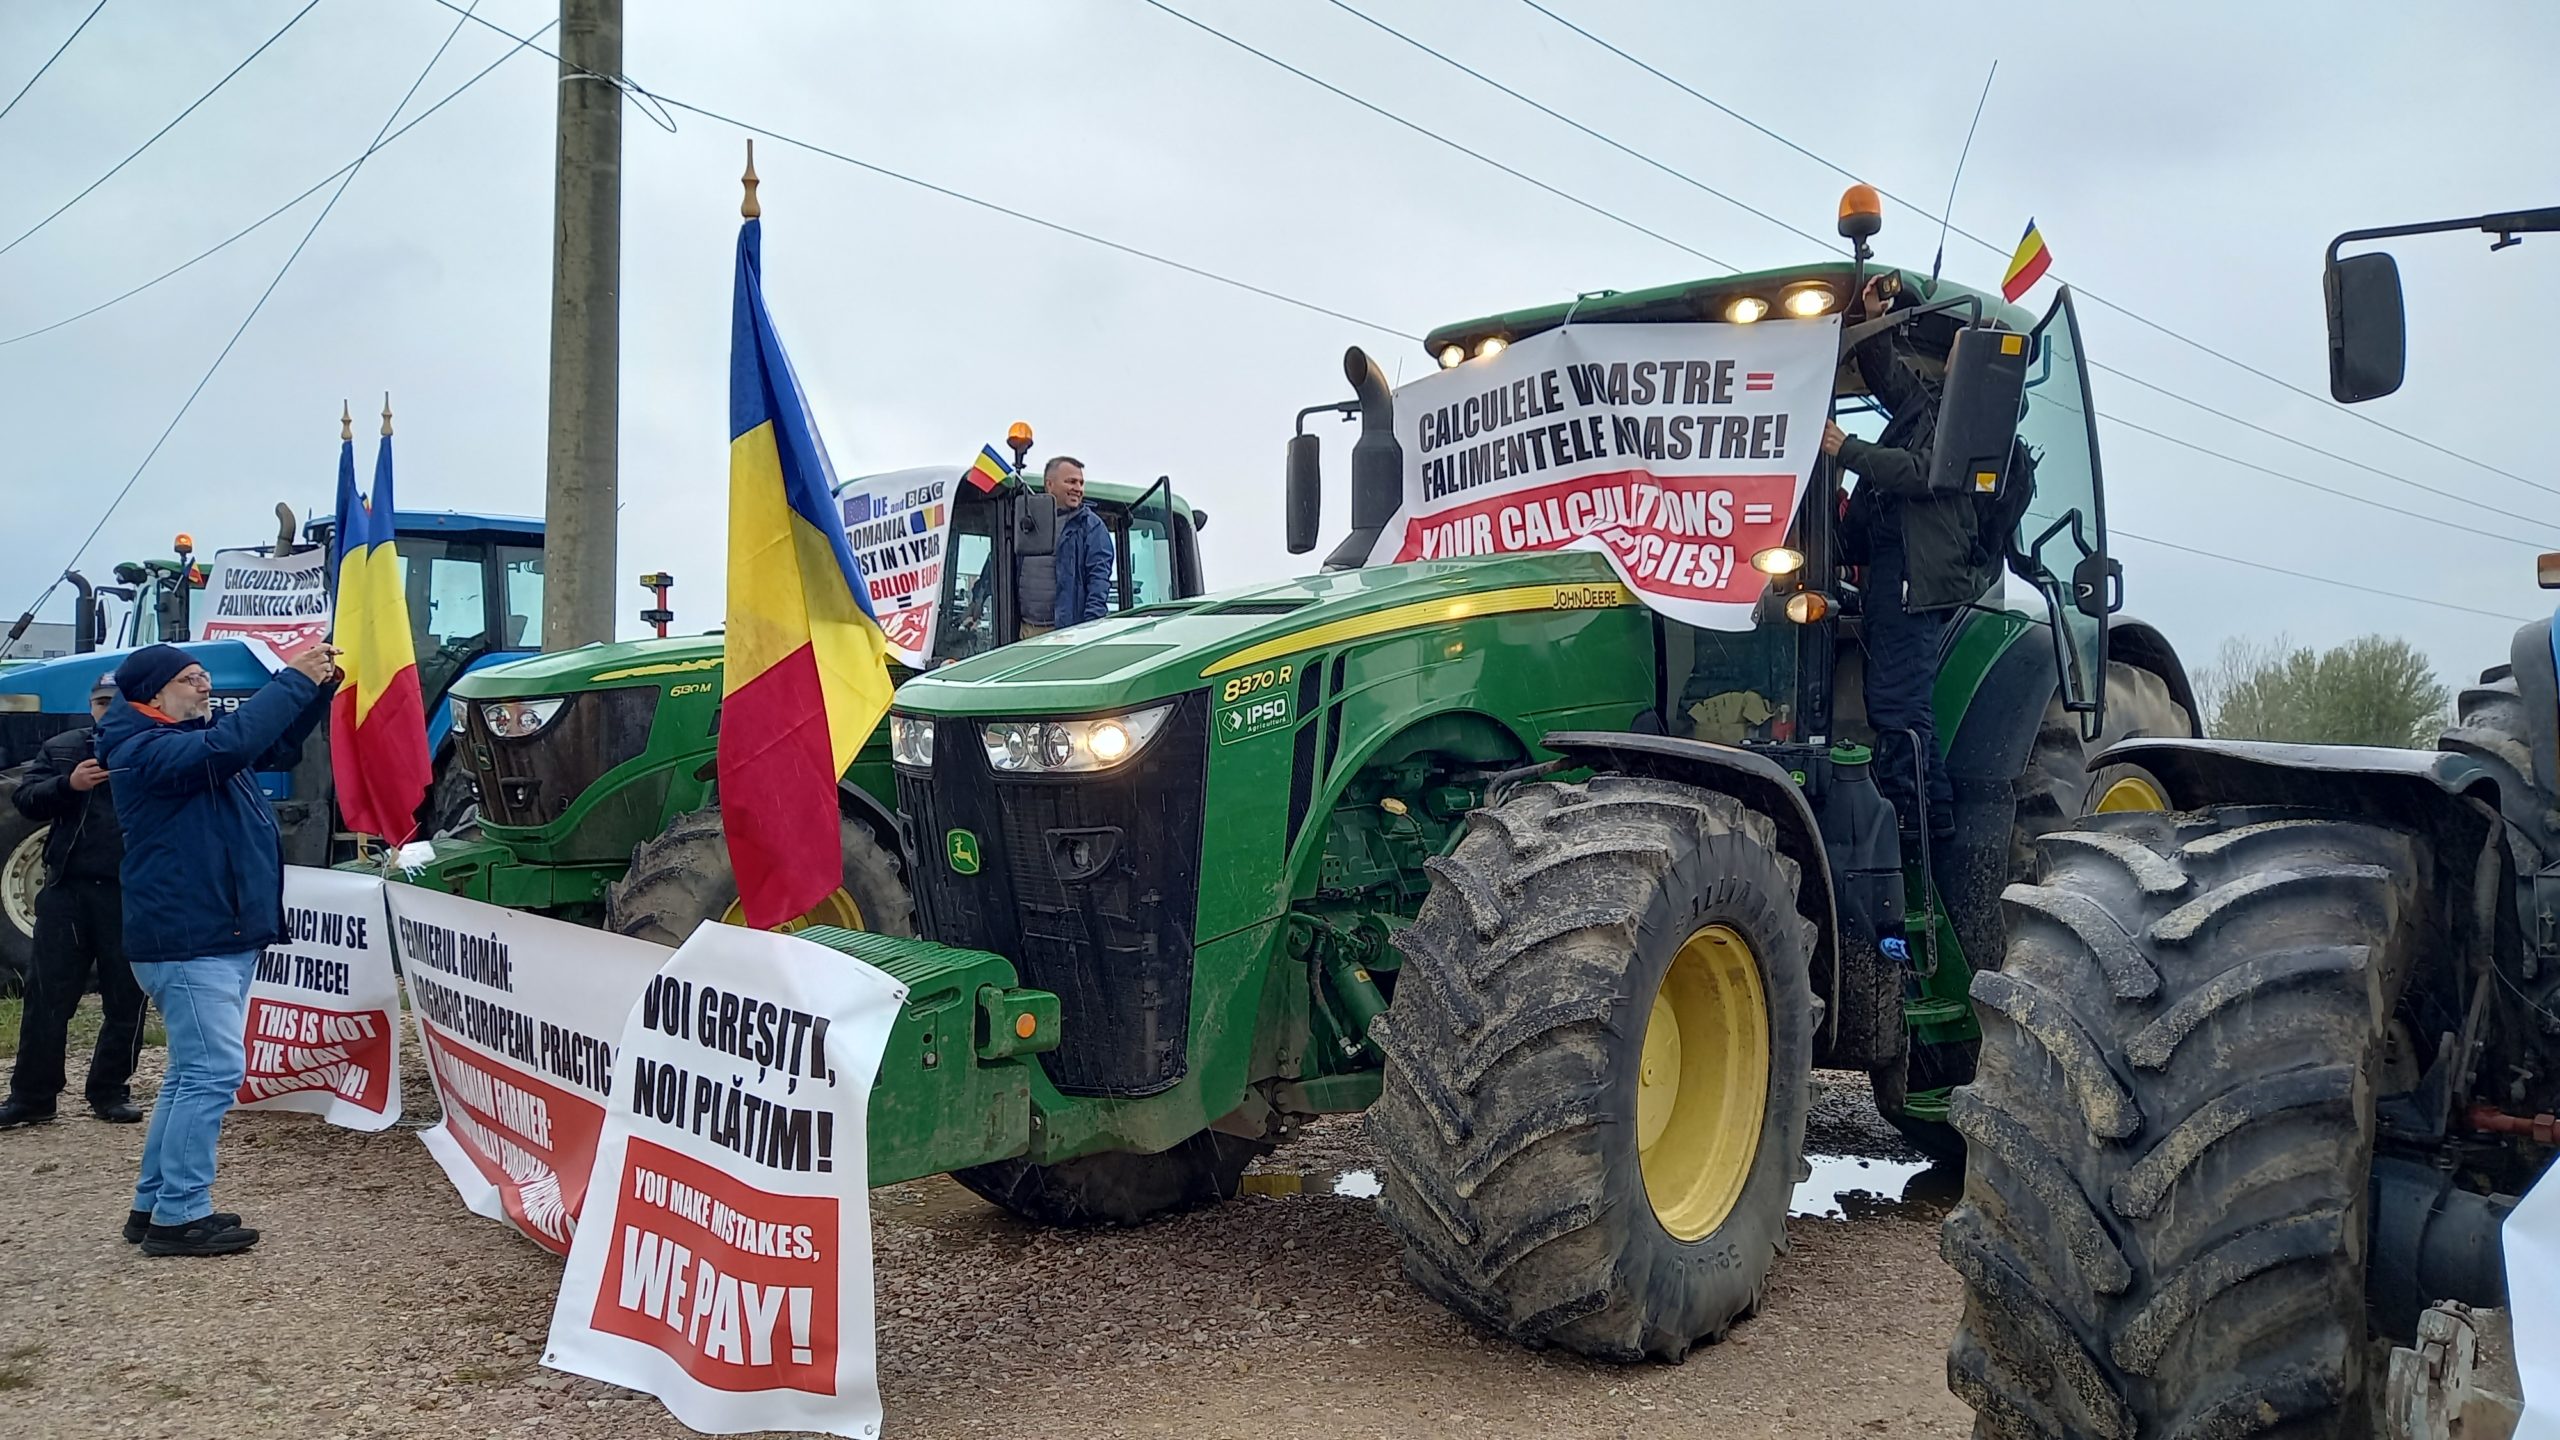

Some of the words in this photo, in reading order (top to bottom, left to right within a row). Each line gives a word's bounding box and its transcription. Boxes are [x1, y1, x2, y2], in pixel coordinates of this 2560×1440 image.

[1418, 369, 1564, 454] CALCULELE
[1566, 360, 1735, 406] VOASTRE
[1421, 415, 1607, 502] FALIMENTELE
[873, 496, 888, 519] UE
[890, 499, 904, 514] and
[905, 481, 944, 509] BBC
[846, 516, 907, 551] ROMANIA
[879, 546, 898, 570] IN
[898, 543, 909, 566] 1
[909, 533, 940, 563] YEAR
[1421, 513, 1495, 561] YOUR
[224, 568, 292, 590] CALCULELE
[869, 570, 919, 600] BILION
[921, 561, 941, 589] EUR
[217, 594, 294, 616] FALIMENTELE
[700, 683, 712, 693] M
[1223, 670, 1275, 702] 8370
[1278, 665, 1292, 685] R
[1247, 698, 1286, 725] IPSO
[287, 907, 317, 942] AICI
[320, 912, 343, 946] NU
[346, 915, 368, 950] SE
[255, 950, 291, 985] MAI
[295, 955, 349, 995] TRECE!
[460, 931, 513, 993] ROMÂN:
[258, 1004, 299, 1040] THIS
[300, 1011, 319, 1044] IS
[322, 1014, 377, 1044] NOT
[643, 974, 691, 1039] VOI
[251, 1040, 286, 1073] THE
[288, 1045, 350, 1071] WAY
[465, 995, 539, 1072] EUROPEAN,
[540, 1021, 612, 1097] PRACTIC
[492, 1077, 554, 1151] FARMER:
[633, 1057, 687, 1129] NOI
[692, 1076, 833, 1173] PLĂTIM!
[634, 1166, 668, 1205] YOU
[670, 1179, 713, 1231] MAKE
[712, 1199, 820, 1263] MISTAKES,
[618, 1224, 692, 1334] WE
[691, 1257, 813, 1366] PAY!
